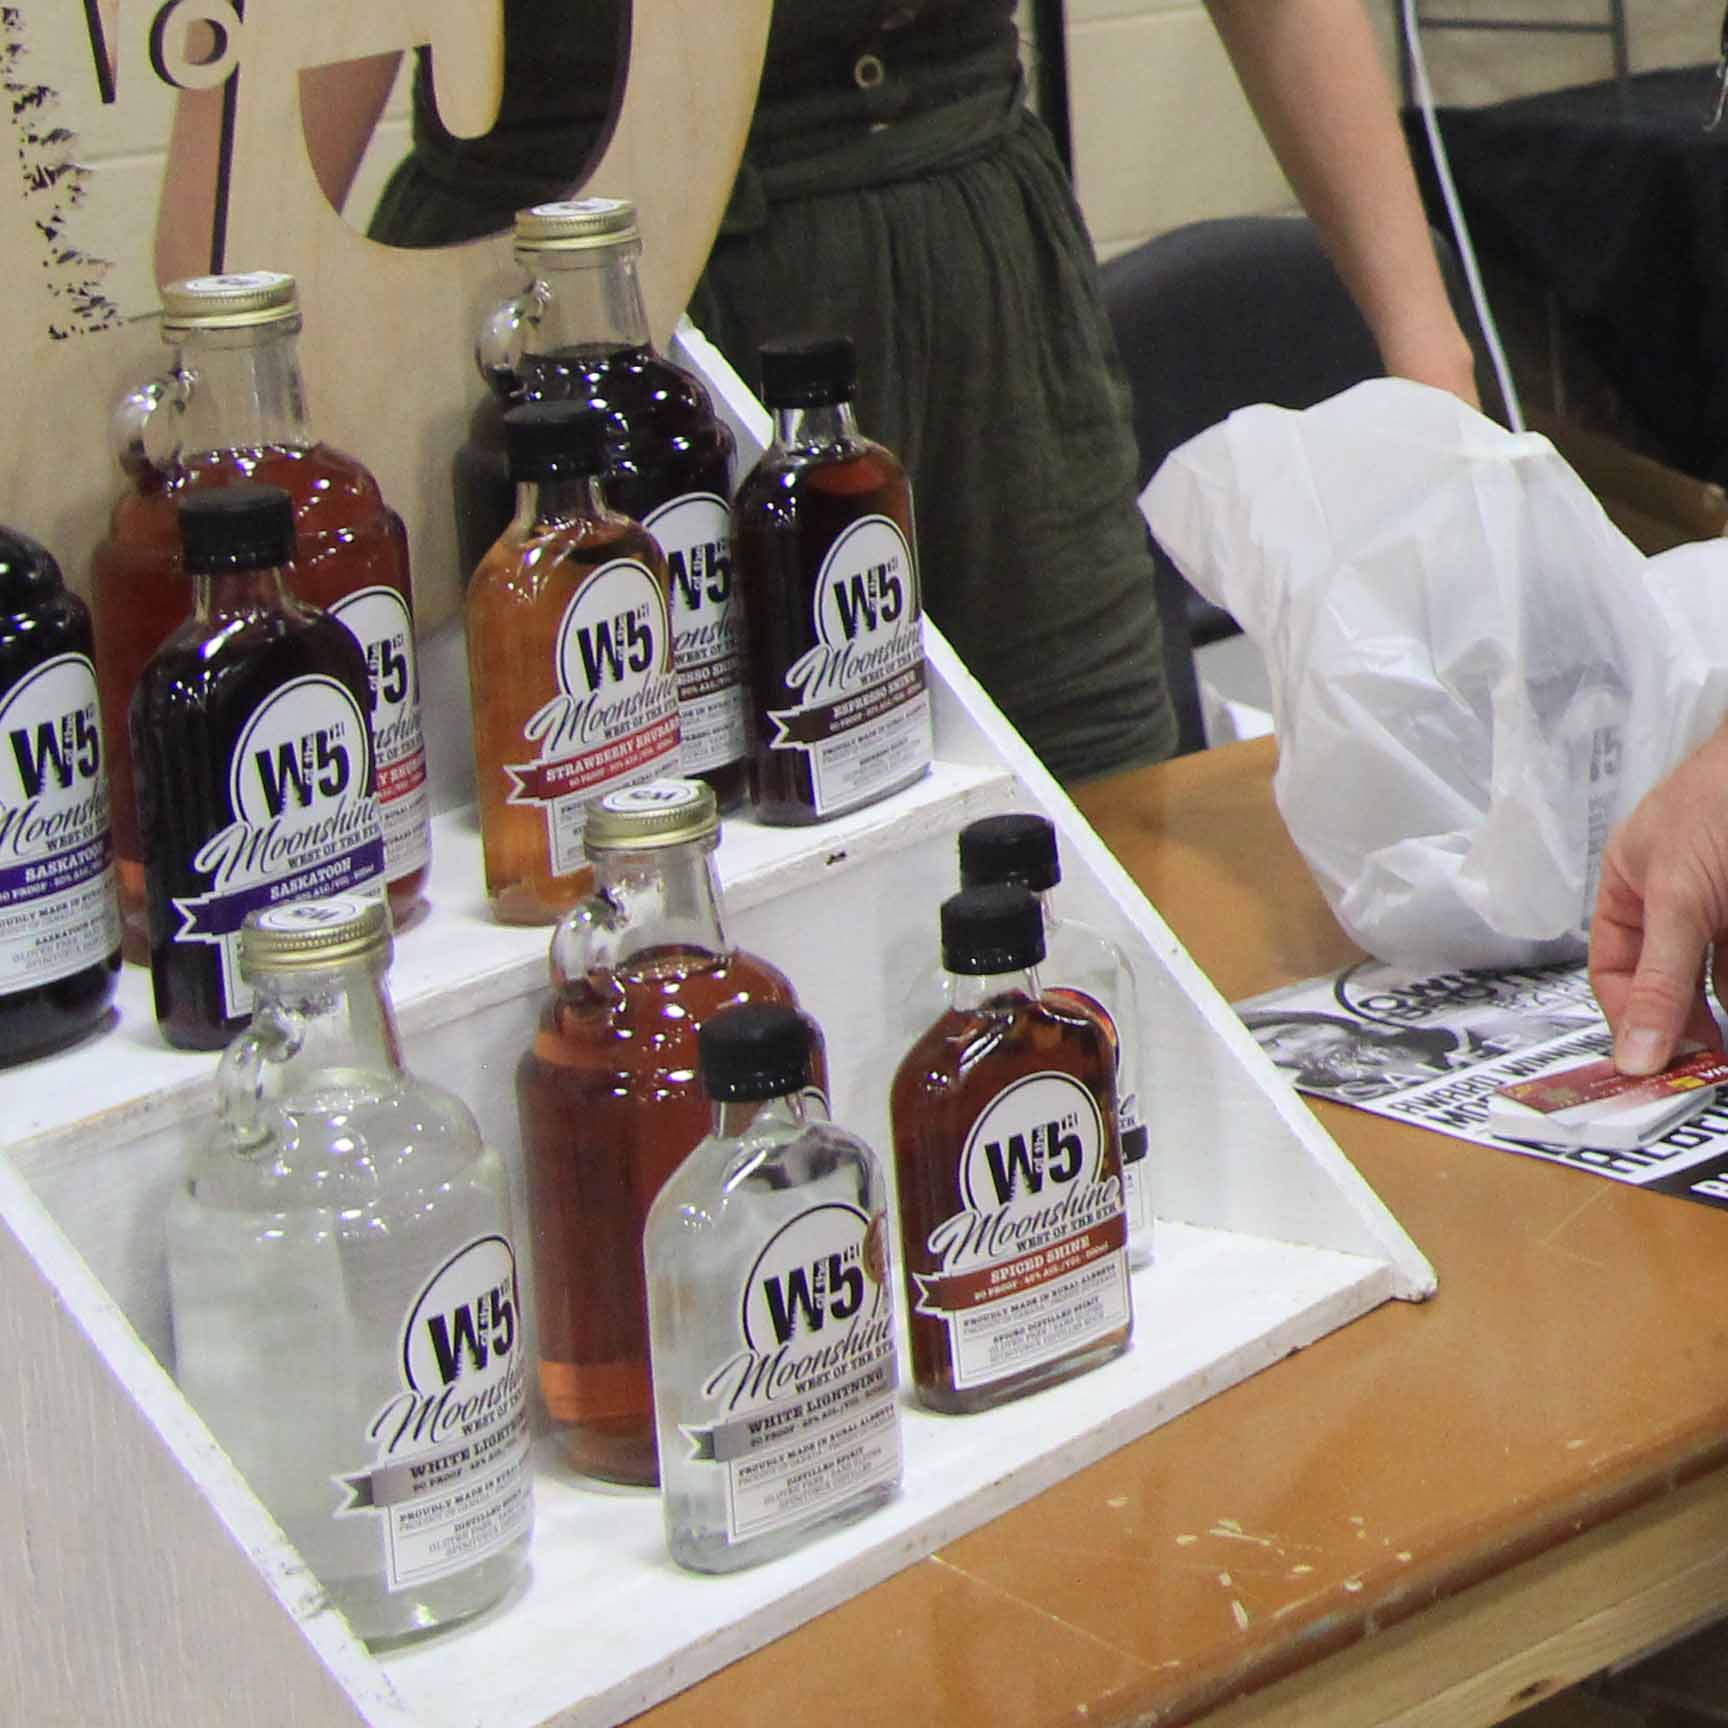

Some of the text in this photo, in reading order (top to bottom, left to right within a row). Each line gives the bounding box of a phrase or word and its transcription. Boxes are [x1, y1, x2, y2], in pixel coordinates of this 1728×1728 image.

[288, 847, 322, 869] WEST
[269, 855, 352, 900] SASKATOON
[932, 1176, 1120, 1265] Moonshine
[1016, 1232, 1051, 1253] WEST
[1051, 1225, 1068, 1243] OF
[1069, 1214, 1094, 1235] THE
[990, 1235, 1091, 1285] SPICED SHINE
[1010, 1296, 1039, 1314] MADE
[794, 1372, 826, 1394] WEST
[826, 1363, 848, 1381] OF
[849, 1353, 875, 1373] THE
[748, 1367, 885, 1435] WHITE LIGHTNING
[461, 1411, 498, 1437] WEST
[409, 1446, 471, 1479] WHITE
[786, 1441, 817, 1460] MADE
[399, 1497, 453, 1523] PROUDLY
[454, 1486, 483, 1506] MADE
